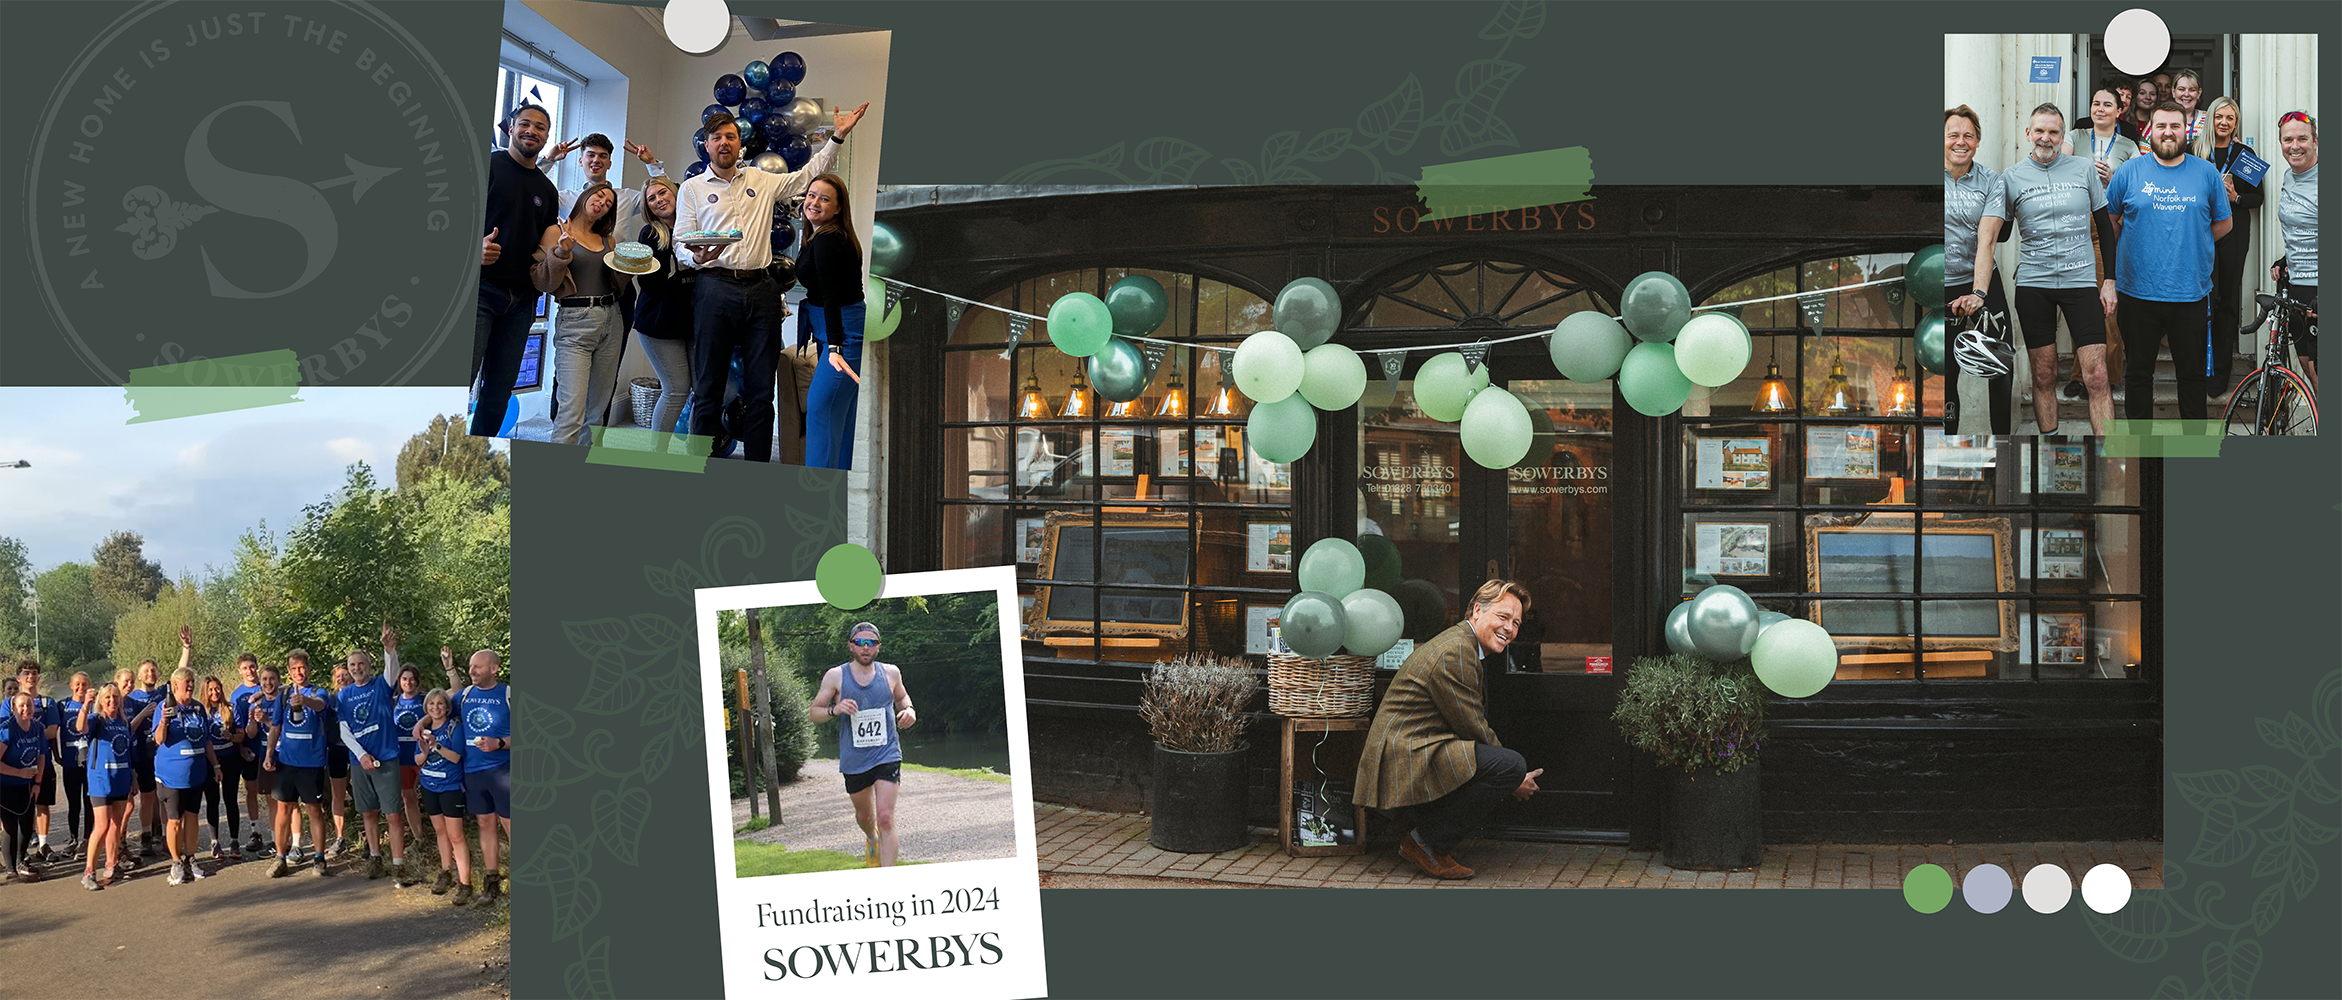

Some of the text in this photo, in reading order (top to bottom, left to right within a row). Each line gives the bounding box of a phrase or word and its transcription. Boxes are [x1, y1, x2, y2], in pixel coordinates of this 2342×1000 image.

[2020, 181, 2081, 196] SOWERBYS
[2154, 186, 2177, 194] mind
[2032, 193, 2057, 202] RIDING
[2153, 194, 2181, 202] Norfolk
[2045, 200, 2068, 208] CAUSE
[2152, 202, 2186, 213] Waveney
[1373, 202, 1596, 233] SOWERBYS
[1362, 465, 1455, 480] SOWERBYS
[1513, 466, 1608, 480] SOWERBYS
[1384, 483, 1412, 493] 01328
[1415, 484, 1452, 493] 730340
[1513, 484, 1608, 496] www.sowerbys.com
[857, 720, 882, 738] 642
